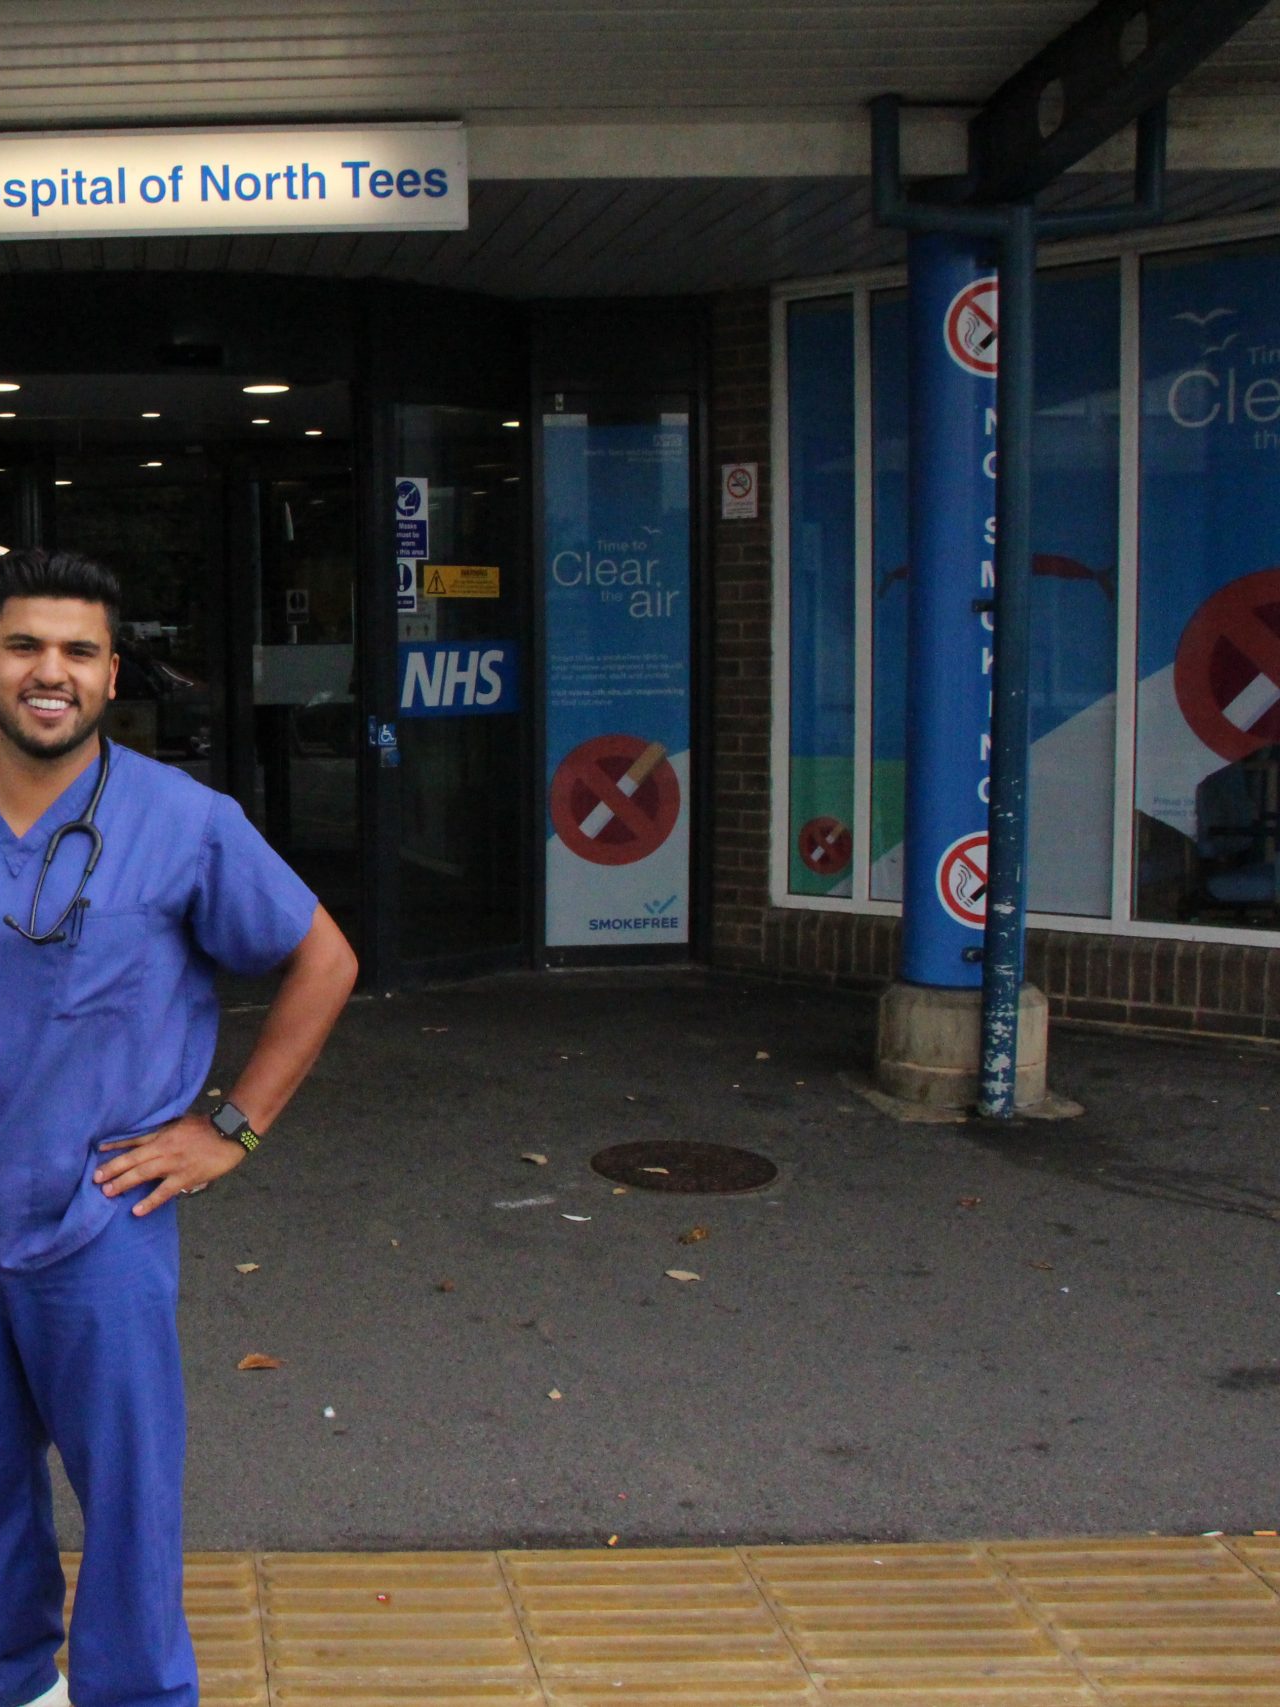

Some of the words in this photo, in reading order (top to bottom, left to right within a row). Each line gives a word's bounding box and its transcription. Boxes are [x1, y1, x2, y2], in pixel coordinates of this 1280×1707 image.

[139, 165, 183, 203] of
[201, 163, 327, 201] North
[341, 161, 449, 199] Tees
[1169, 368, 1280, 429] Cle
[597, 540, 629, 552] Time
[632, 540, 648, 551] to
[552, 551, 660, 587] Clear
[601, 590, 623, 602] the
[628, 580, 680, 619] air
[401, 649, 504, 708] NHS
[589, 917, 678, 931] SMOKEFREE
